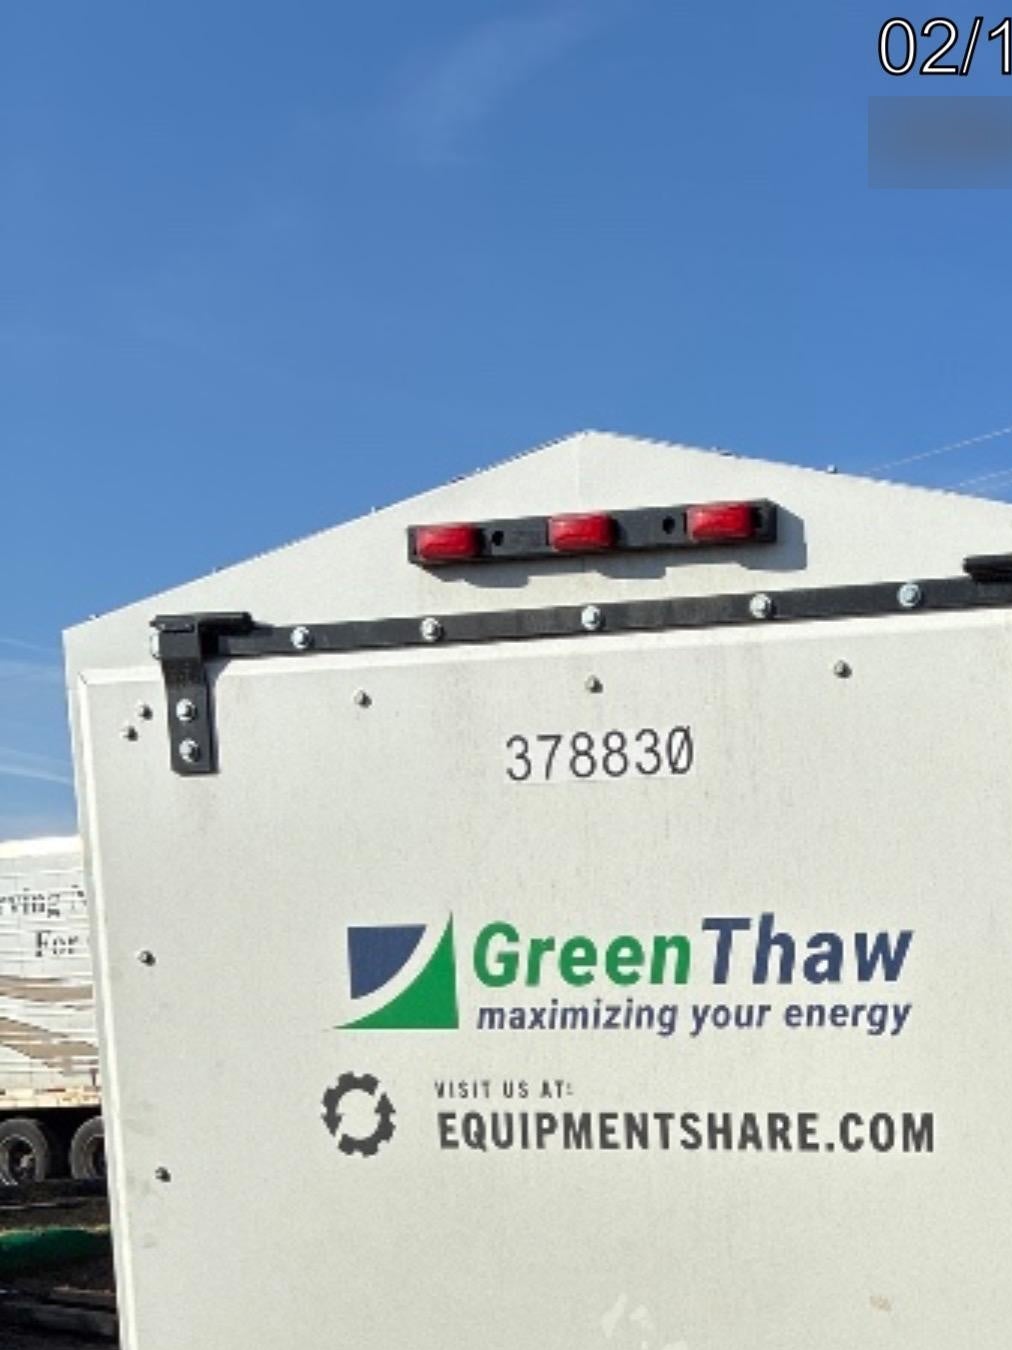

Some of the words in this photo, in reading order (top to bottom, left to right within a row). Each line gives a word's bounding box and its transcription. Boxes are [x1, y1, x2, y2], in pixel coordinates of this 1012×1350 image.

[505, 725, 694, 782] 378830
[472, 911, 914, 988] GreenThaw
[476, 997, 679, 1038] maximizing
[689, 1004, 772, 1039] your
[783, 1003, 913, 1037] energy
[434, 1079, 490, 1100] VISIT
[502, 1079, 529, 1100] US
[540, 1079, 574, 1100] AT:
[437, 1111, 934, 1153] EQUIPMENTSHARE.COM
